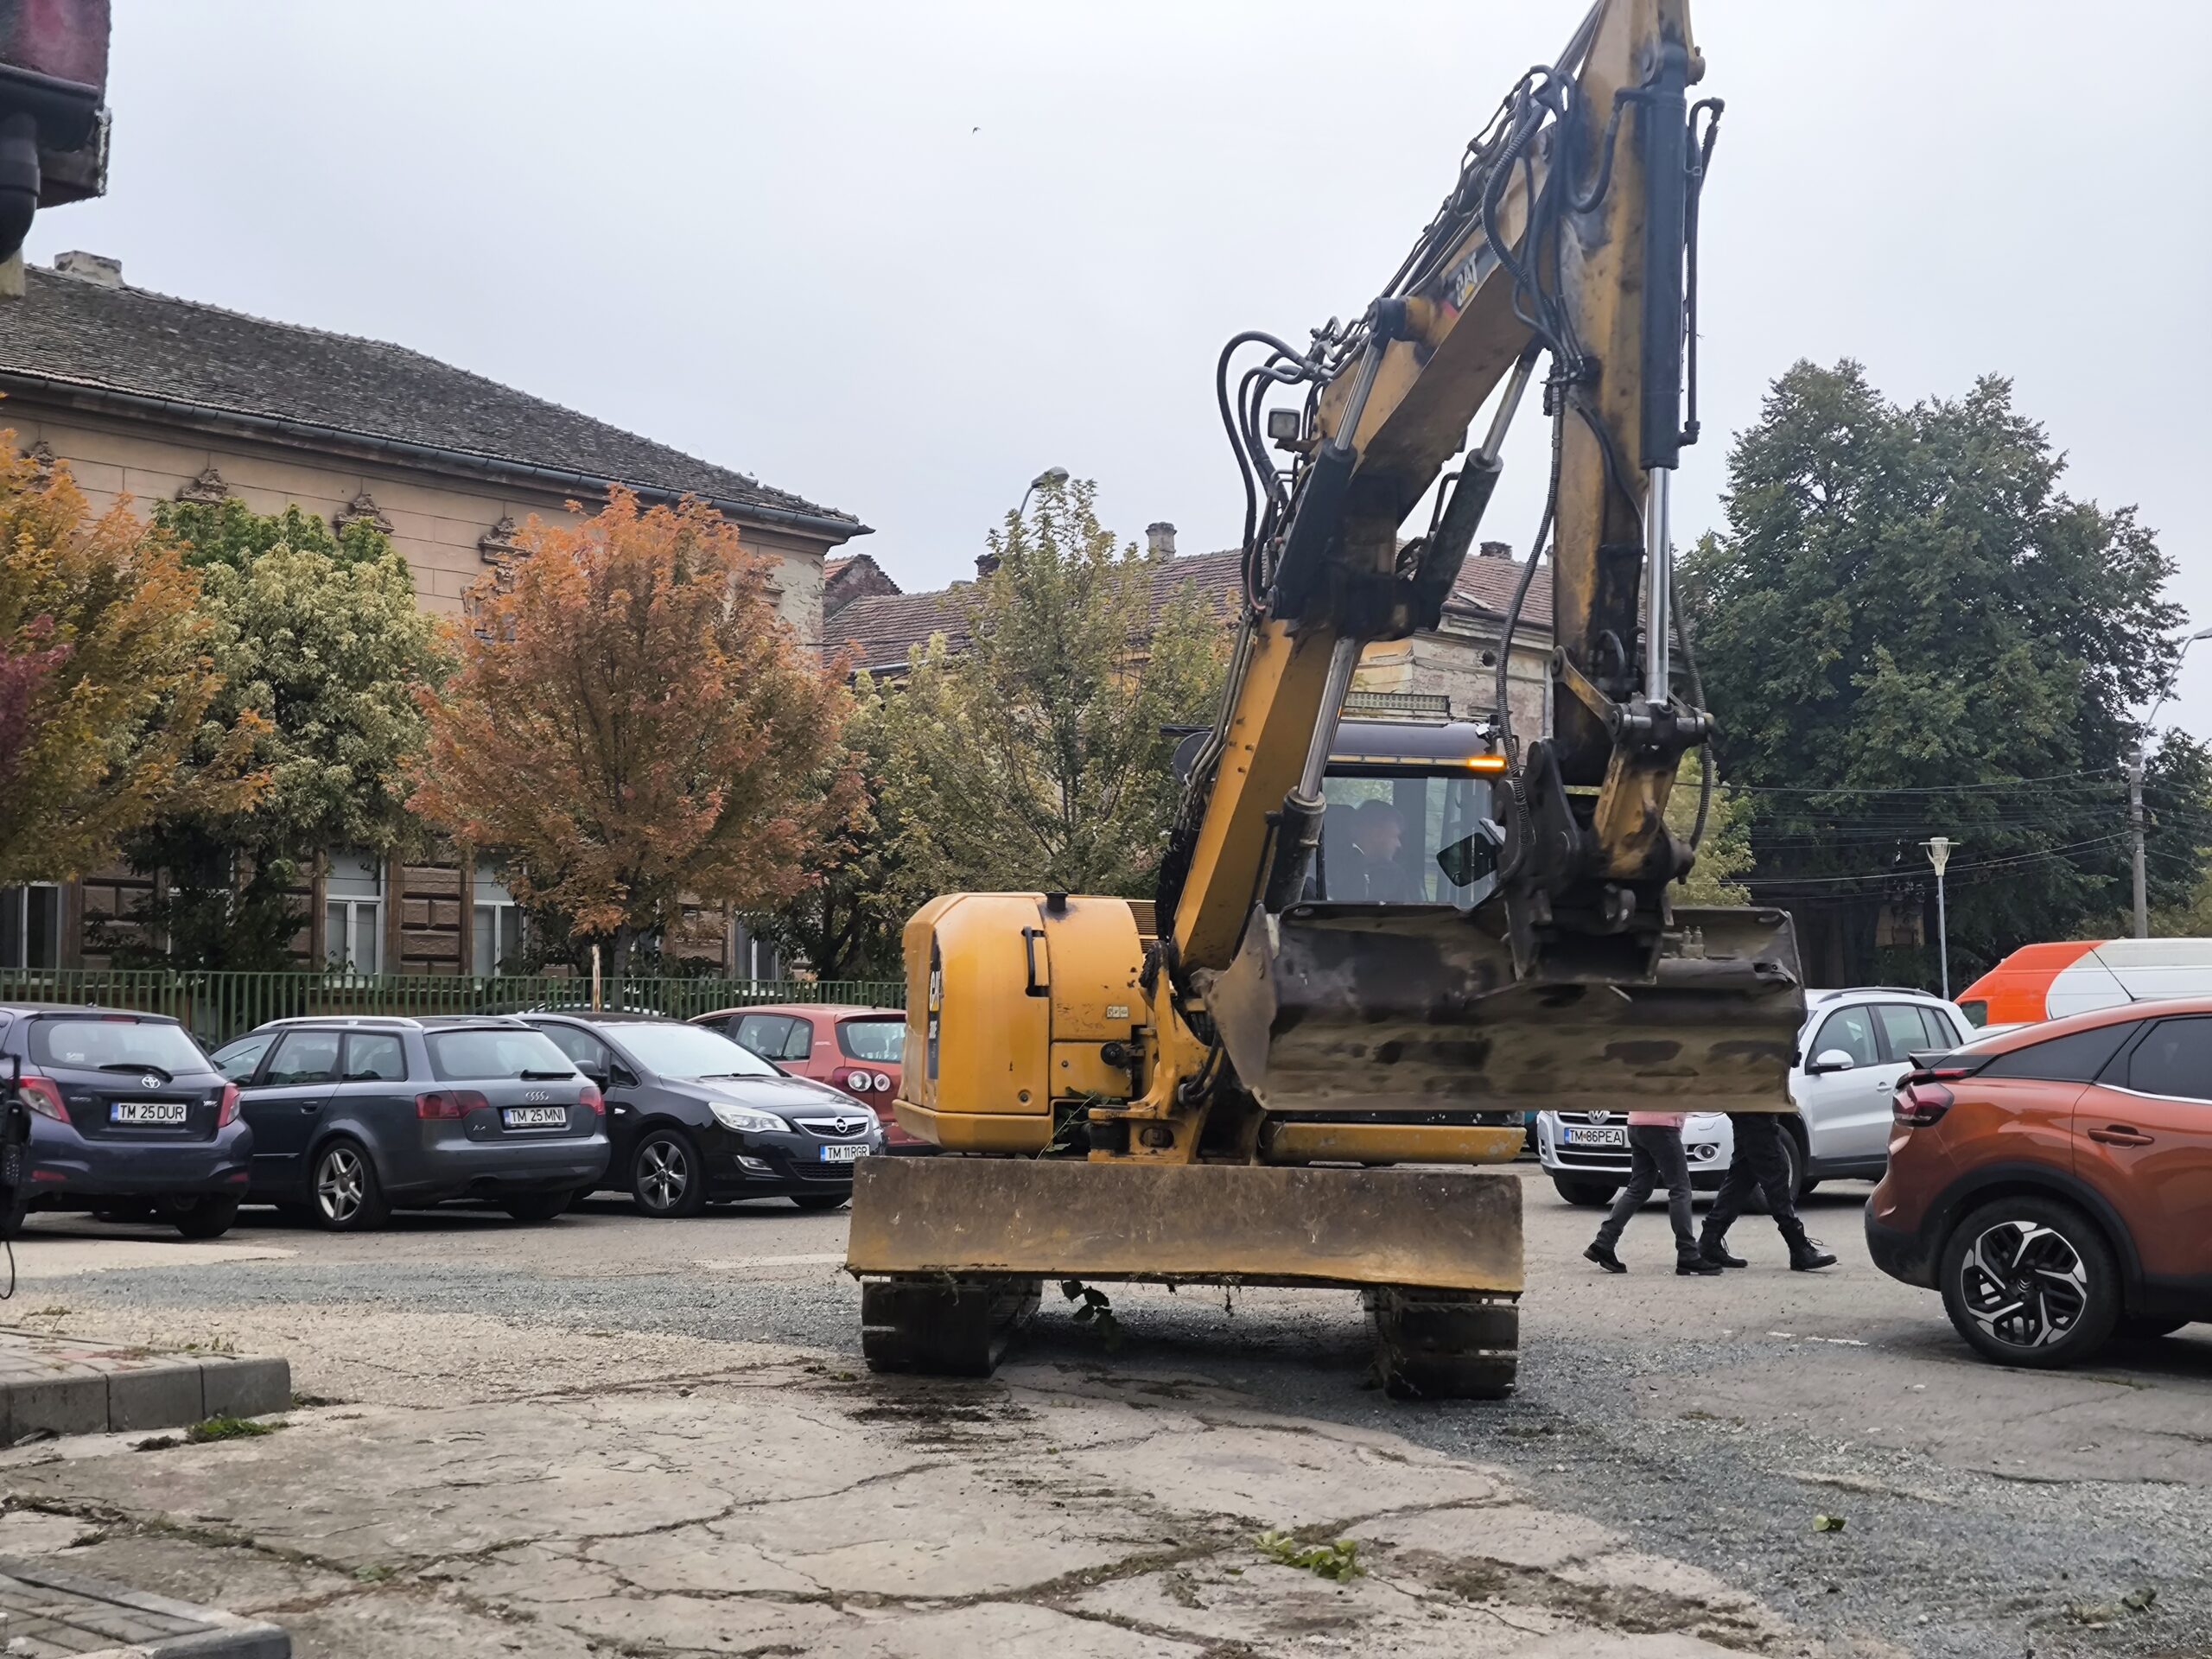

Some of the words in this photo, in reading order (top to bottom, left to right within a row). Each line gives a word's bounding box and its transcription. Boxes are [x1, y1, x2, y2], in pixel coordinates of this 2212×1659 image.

[1456, 251, 1478, 307] CAT
[120, 1105, 137, 1119] TM
[511, 1109, 527, 1122] TM
[1569, 1129, 1583, 1141] TM
[828, 1147, 842, 1160] TM
